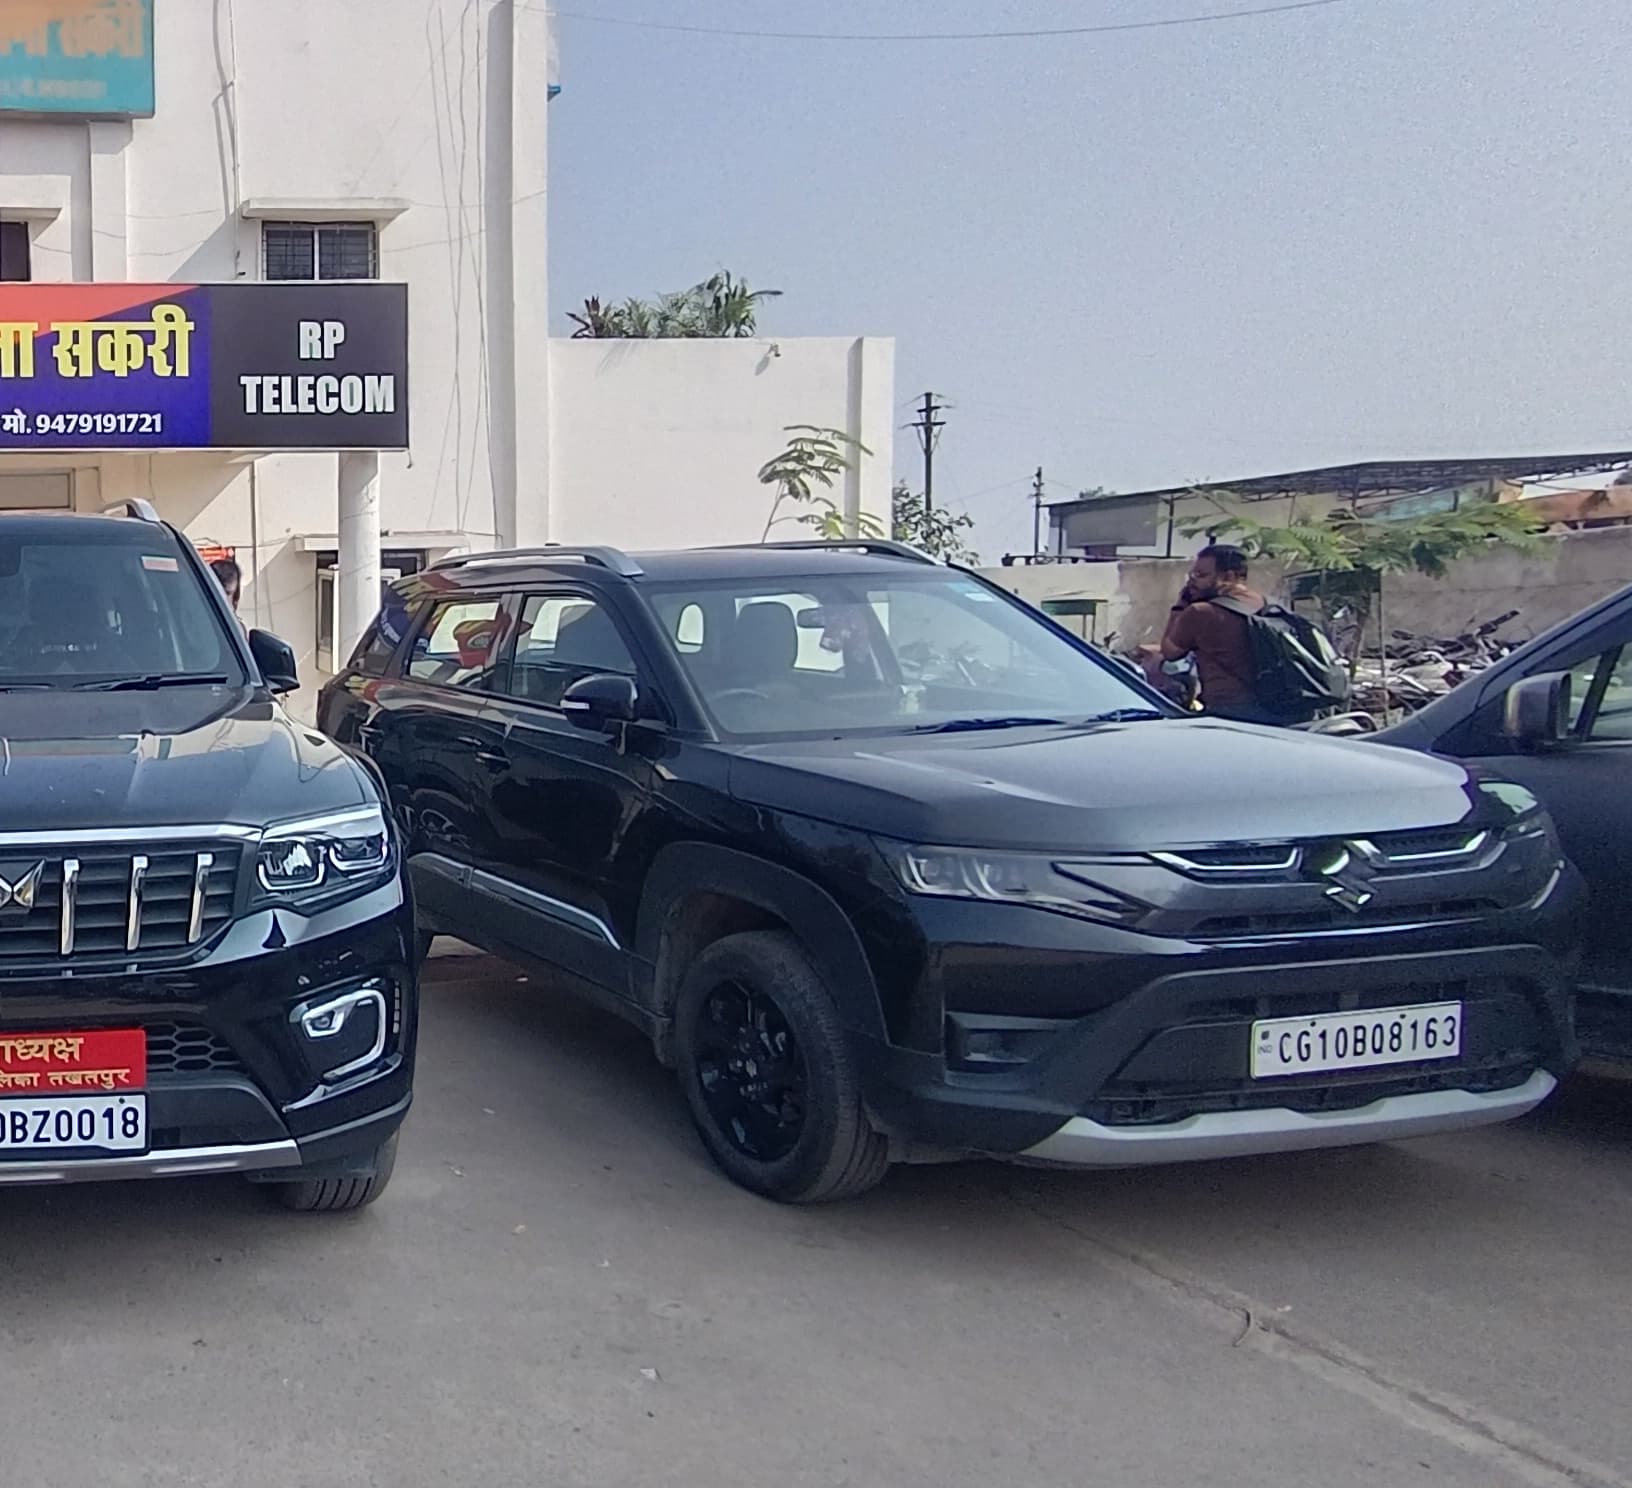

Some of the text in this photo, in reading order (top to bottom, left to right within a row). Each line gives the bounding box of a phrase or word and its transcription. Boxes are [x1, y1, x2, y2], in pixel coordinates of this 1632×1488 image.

[50, 304, 195, 377] सकरी
[298, 321, 346, 360] RP
[240, 374, 395, 414] TELECOM
[1, 409, 32, 435] मो.
[35, 413, 164, 436] 9479191721
[47, 1068, 131, 1090] तखतपुर
